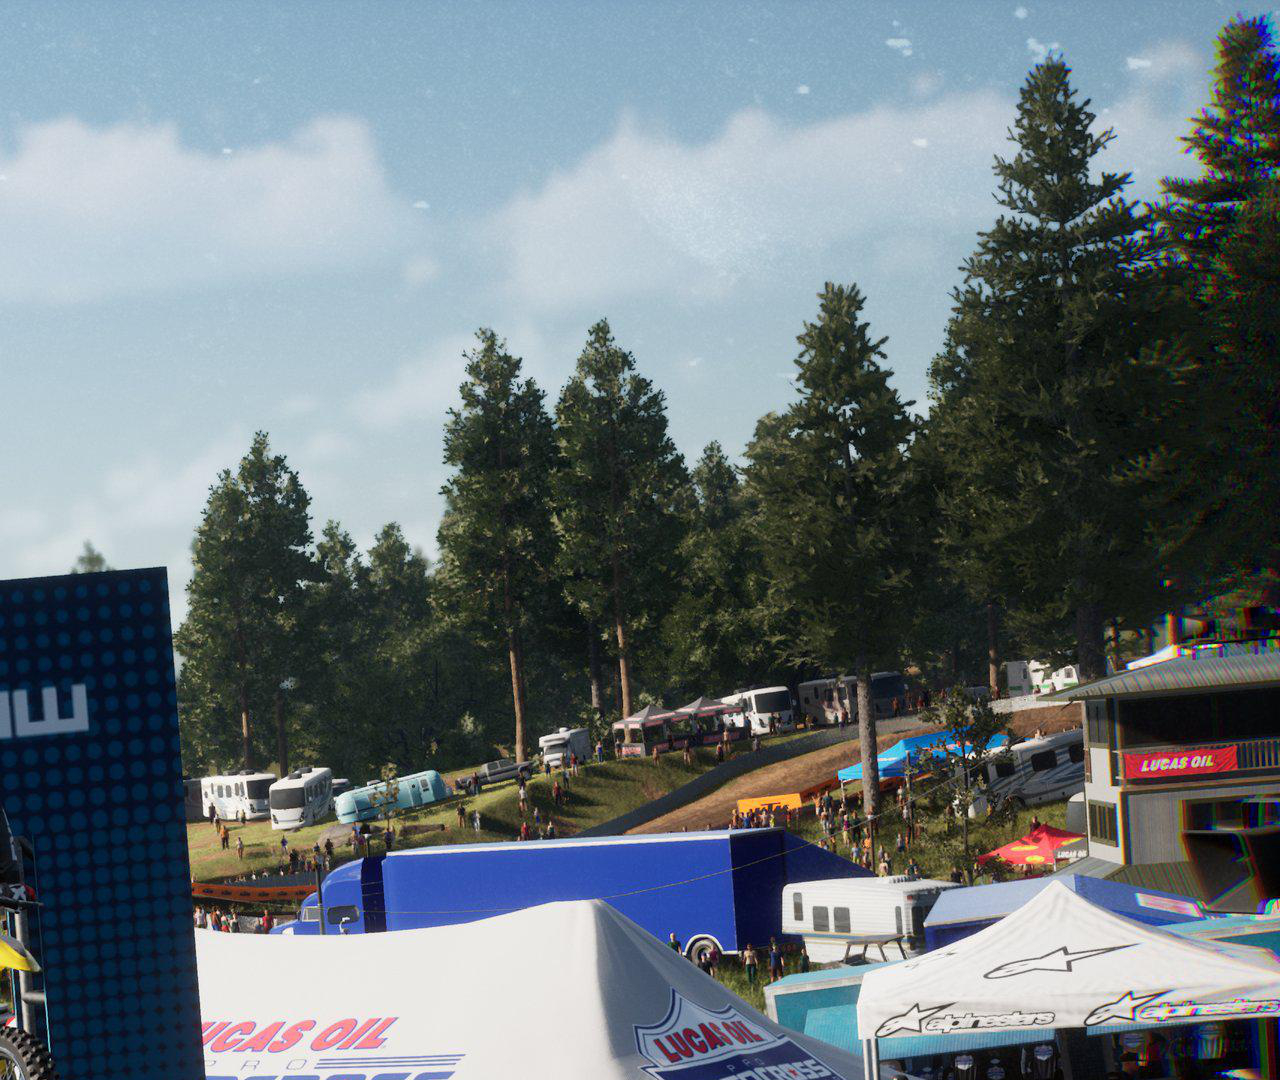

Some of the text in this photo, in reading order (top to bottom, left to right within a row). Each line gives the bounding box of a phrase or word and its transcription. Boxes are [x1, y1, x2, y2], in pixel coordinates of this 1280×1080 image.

[1140, 754, 1214, 773] LUCAS OIL
[202, 1016, 399, 1053] UCAS OIL
[653, 1019, 765, 1064] LUCAS OIL
[726, 1056, 765, 1072] PRO
